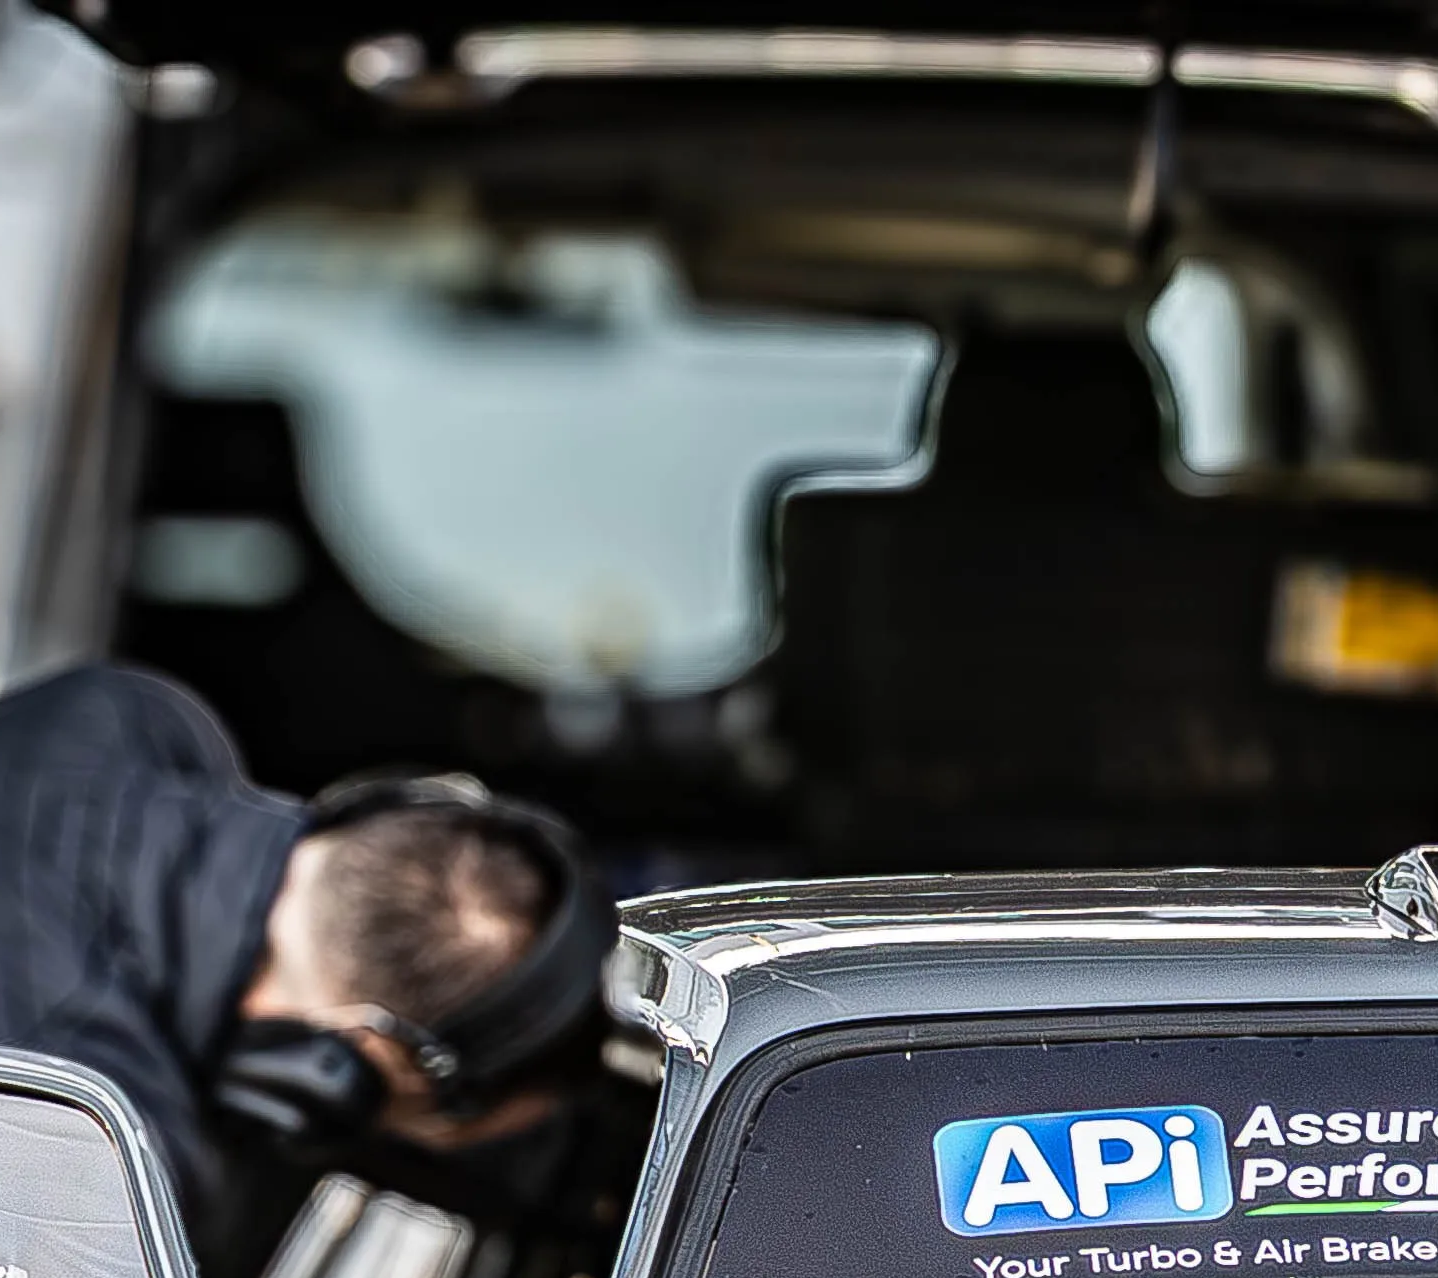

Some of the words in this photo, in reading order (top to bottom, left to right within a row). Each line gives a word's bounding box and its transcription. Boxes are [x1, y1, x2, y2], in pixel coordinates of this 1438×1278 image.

[1078, 1244, 1202, 1273] Turbo
[1213, 1240, 1242, 1266] &
[1254, 1238, 1311, 1265] Air
[1321, 1235, 1438, 1263] Brake
